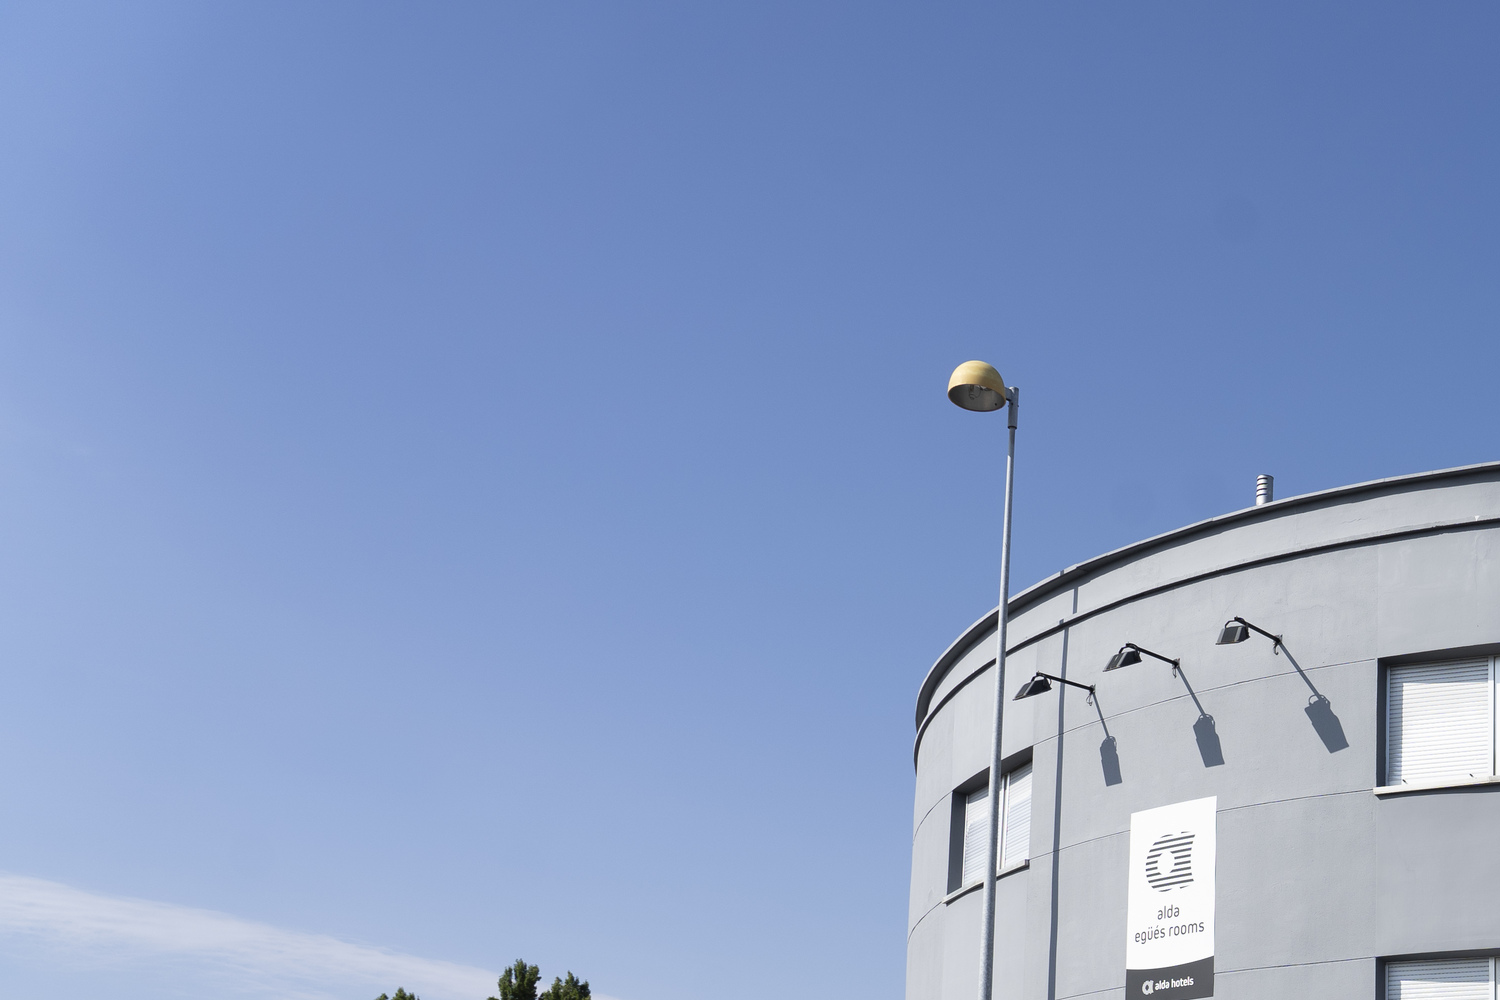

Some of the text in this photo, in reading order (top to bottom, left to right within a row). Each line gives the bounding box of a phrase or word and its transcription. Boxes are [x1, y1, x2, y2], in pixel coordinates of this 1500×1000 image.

[1157, 904, 1180, 920] alda
[1135, 921, 1205, 945] egüés rooms
[1154, 976, 1194, 991] alda hotels
